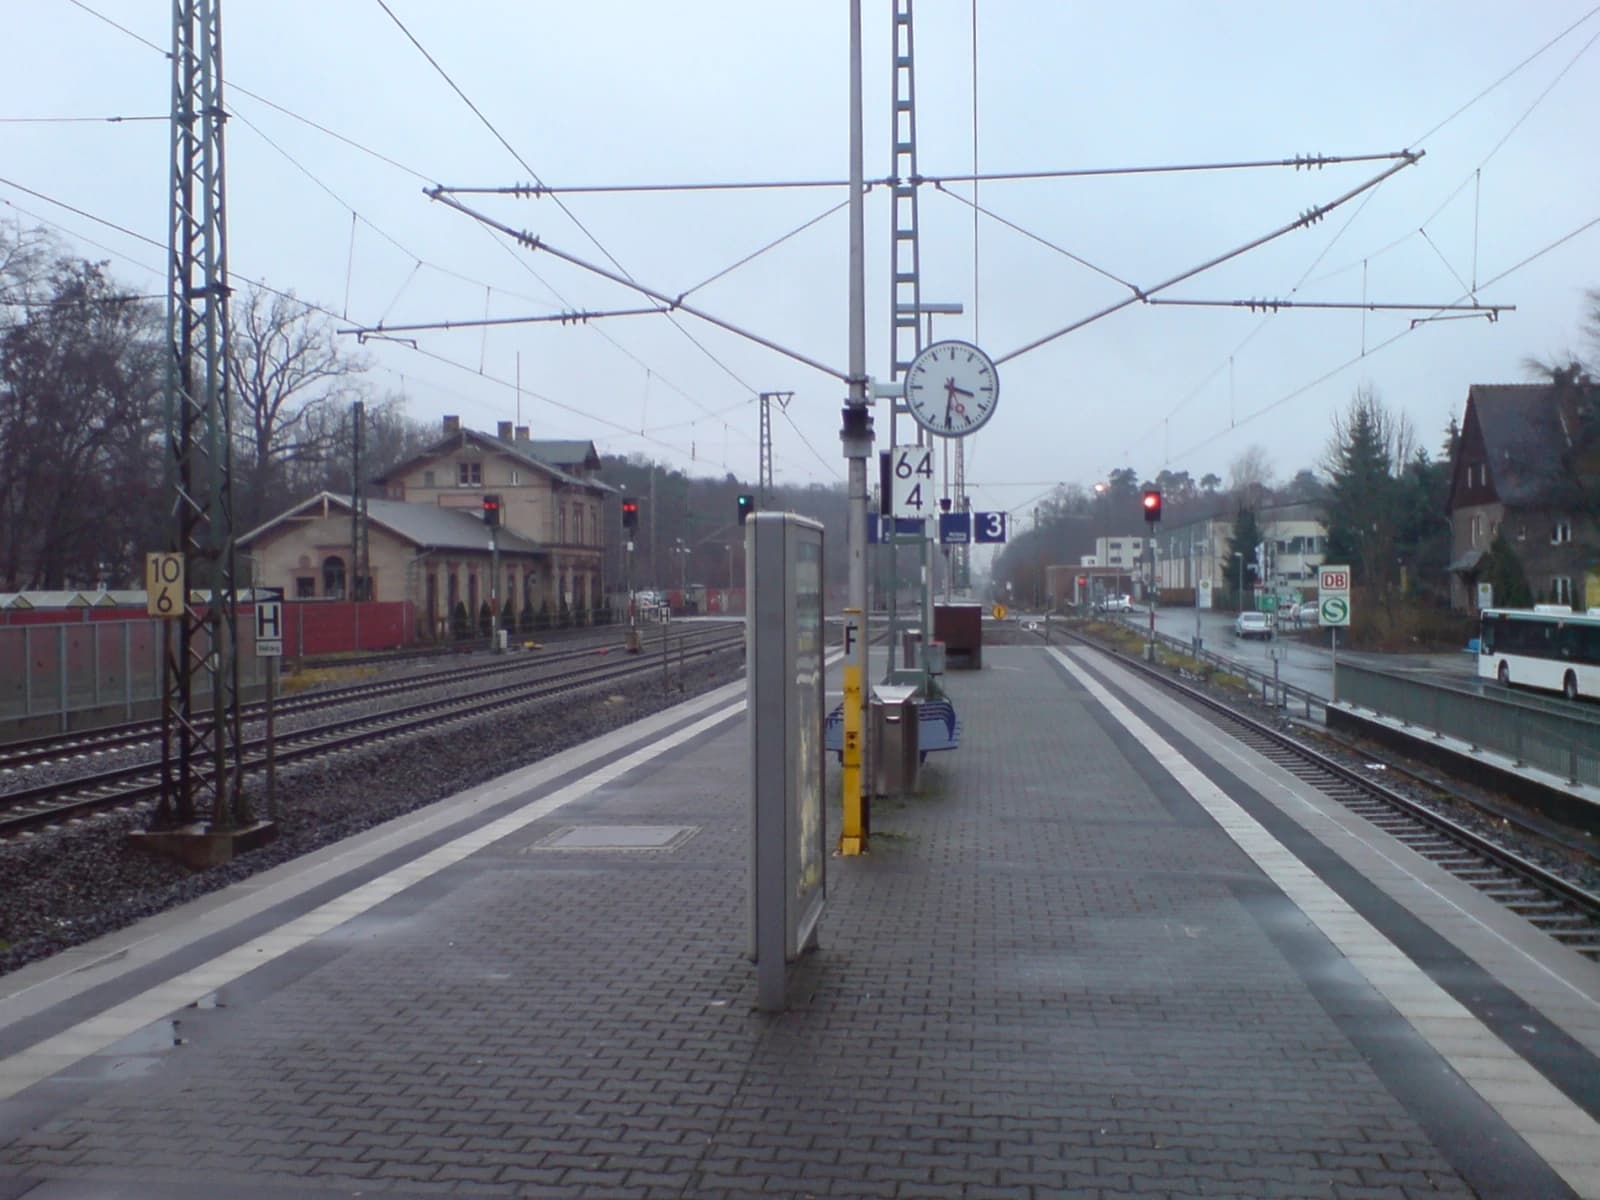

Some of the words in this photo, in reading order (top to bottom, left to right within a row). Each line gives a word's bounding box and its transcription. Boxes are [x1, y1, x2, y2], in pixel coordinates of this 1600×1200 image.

[895, 451, 933, 479] 64
[905, 483, 923, 511] 4
[985, 513, 1002, 537] 3
[151, 556, 180, 583] 10
[1324, 574, 1345, 588] DB
[157, 586, 173, 613] 6
[1324, 598, 1345, 622] S
[258, 604, 279, 637] H
[845, 626, 858, 655] F
